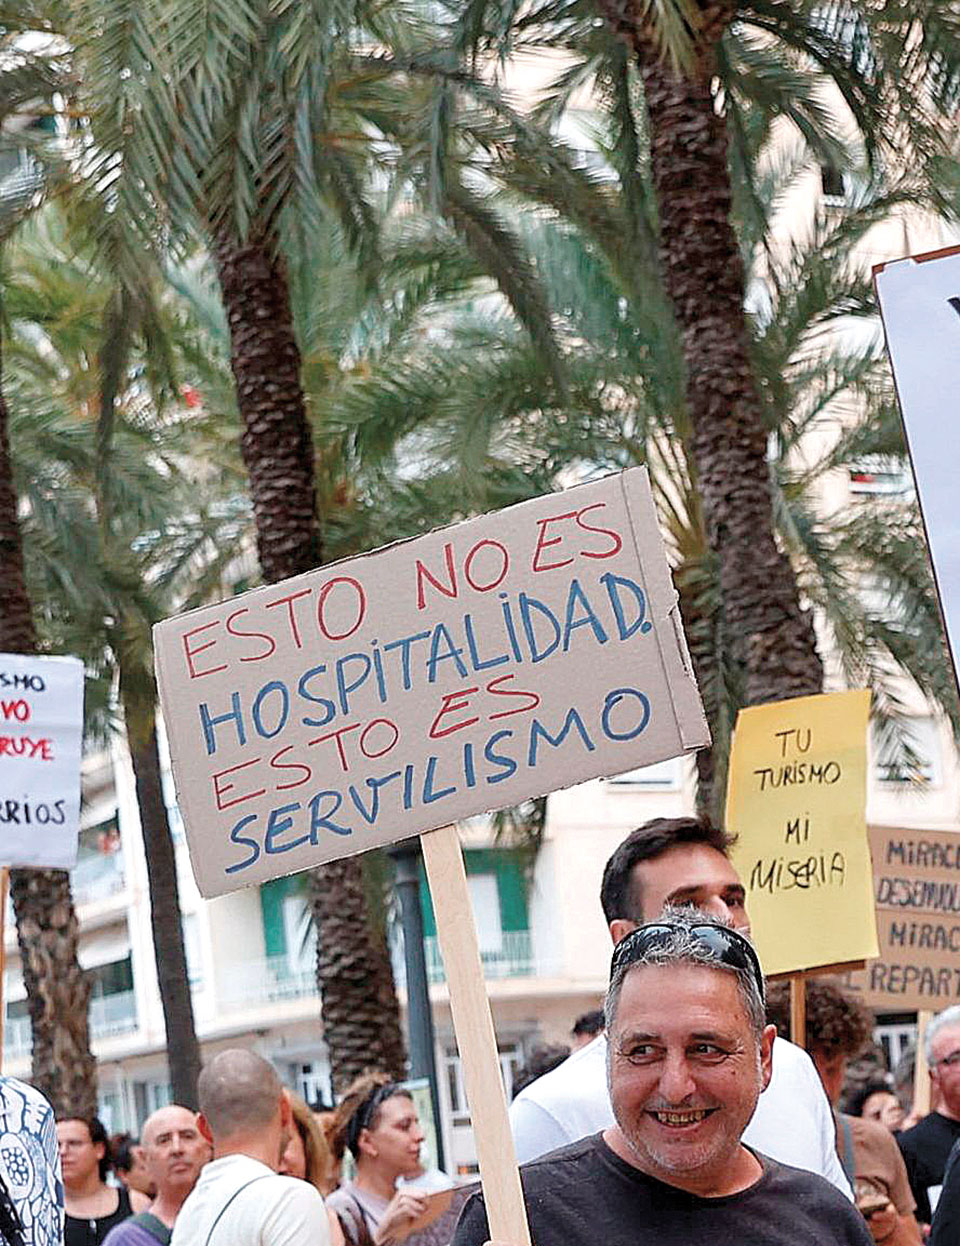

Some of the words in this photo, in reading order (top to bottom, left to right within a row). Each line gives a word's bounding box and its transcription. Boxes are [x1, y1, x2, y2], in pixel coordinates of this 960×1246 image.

[182, 577, 366, 679] ESTO
[416, 540, 509, 609] NO
[532, 503, 622, 571] ES
[213, 719, 399, 810] ESTO
[430, 675, 539, 738] ES
[225, 688, 650, 873] SERVILISMO
[775, 728, 812, 757] TU
